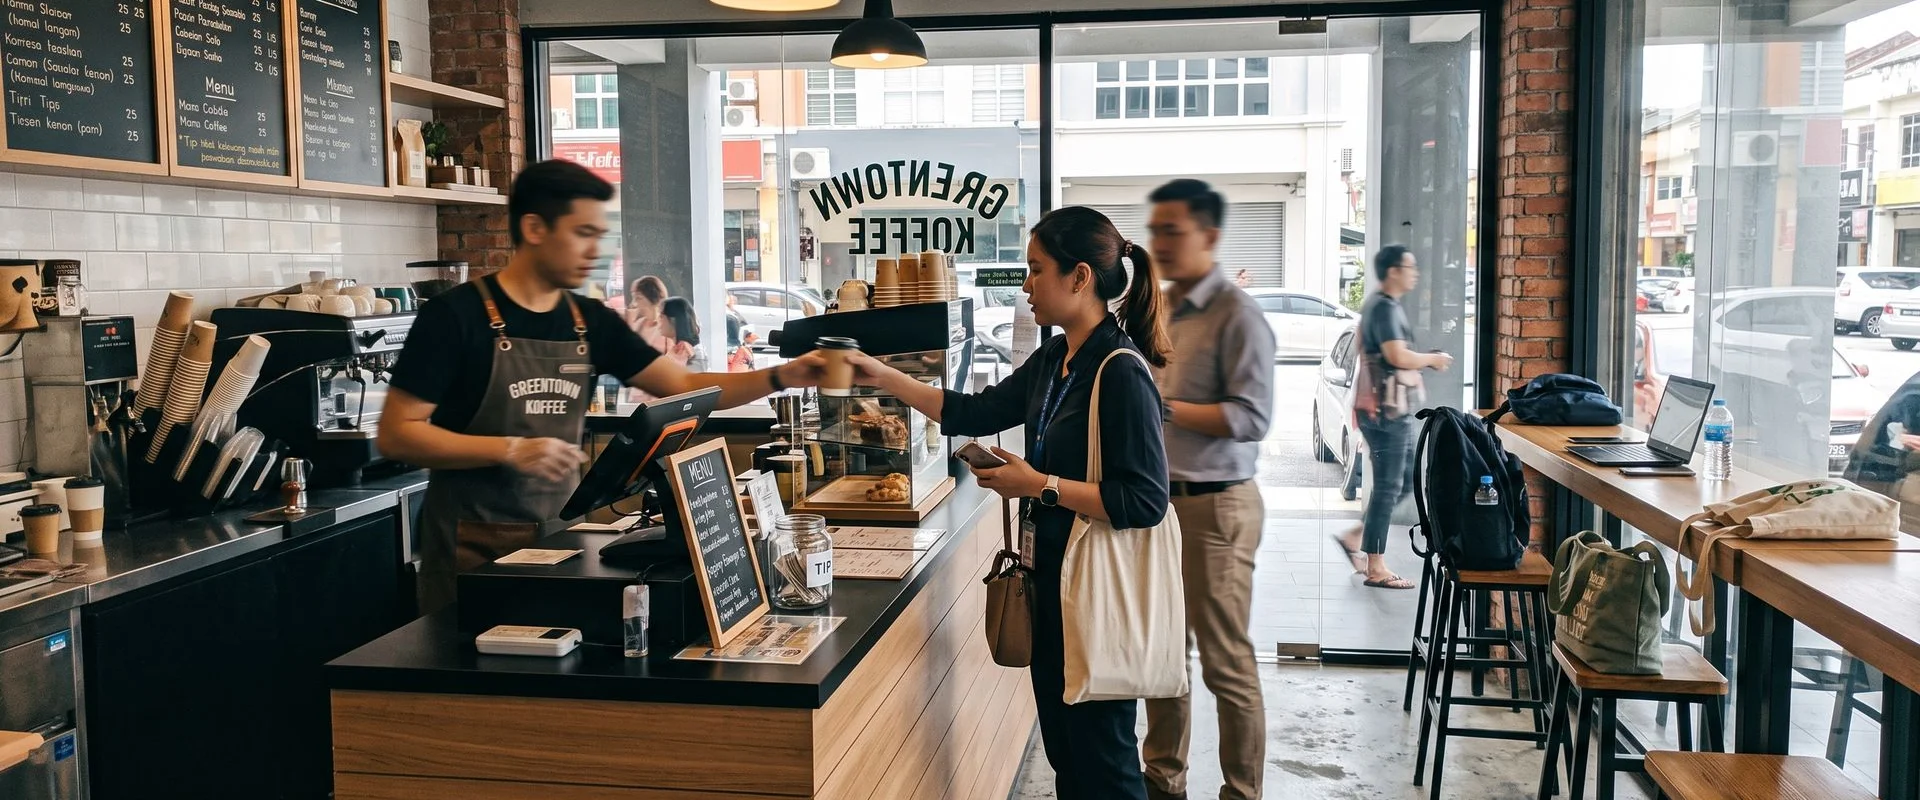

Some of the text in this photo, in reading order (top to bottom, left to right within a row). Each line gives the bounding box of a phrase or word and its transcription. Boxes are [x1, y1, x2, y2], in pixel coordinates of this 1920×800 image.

[118, 3, 145, 19] 25 25
[120, 22, 131, 34] 25
[253, 29, 262, 39] 25
[363, 27, 370, 37] 25
[253, 45, 263, 56] 25
[364, 40, 371, 50] 25
[122, 56, 133, 67] 25
[254, 61, 264, 72] 25
[123, 74, 135, 85] 25
[205, 76, 235, 97] Menu
[126, 108, 137, 120] 25
[257, 112, 266, 122] 25
[46, 117, 73, 131] kenon
[127, 130, 139, 142] 25
[204, 119, 228, 132] Coffee
[258, 128, 267, 137] 25
[508, 377, 581, 400] GREENTOWN
[525, 399, 568, 415] KOFFEE
[687, 456, 714, 484] MENU
[815, 560, 831, 576] TIP
